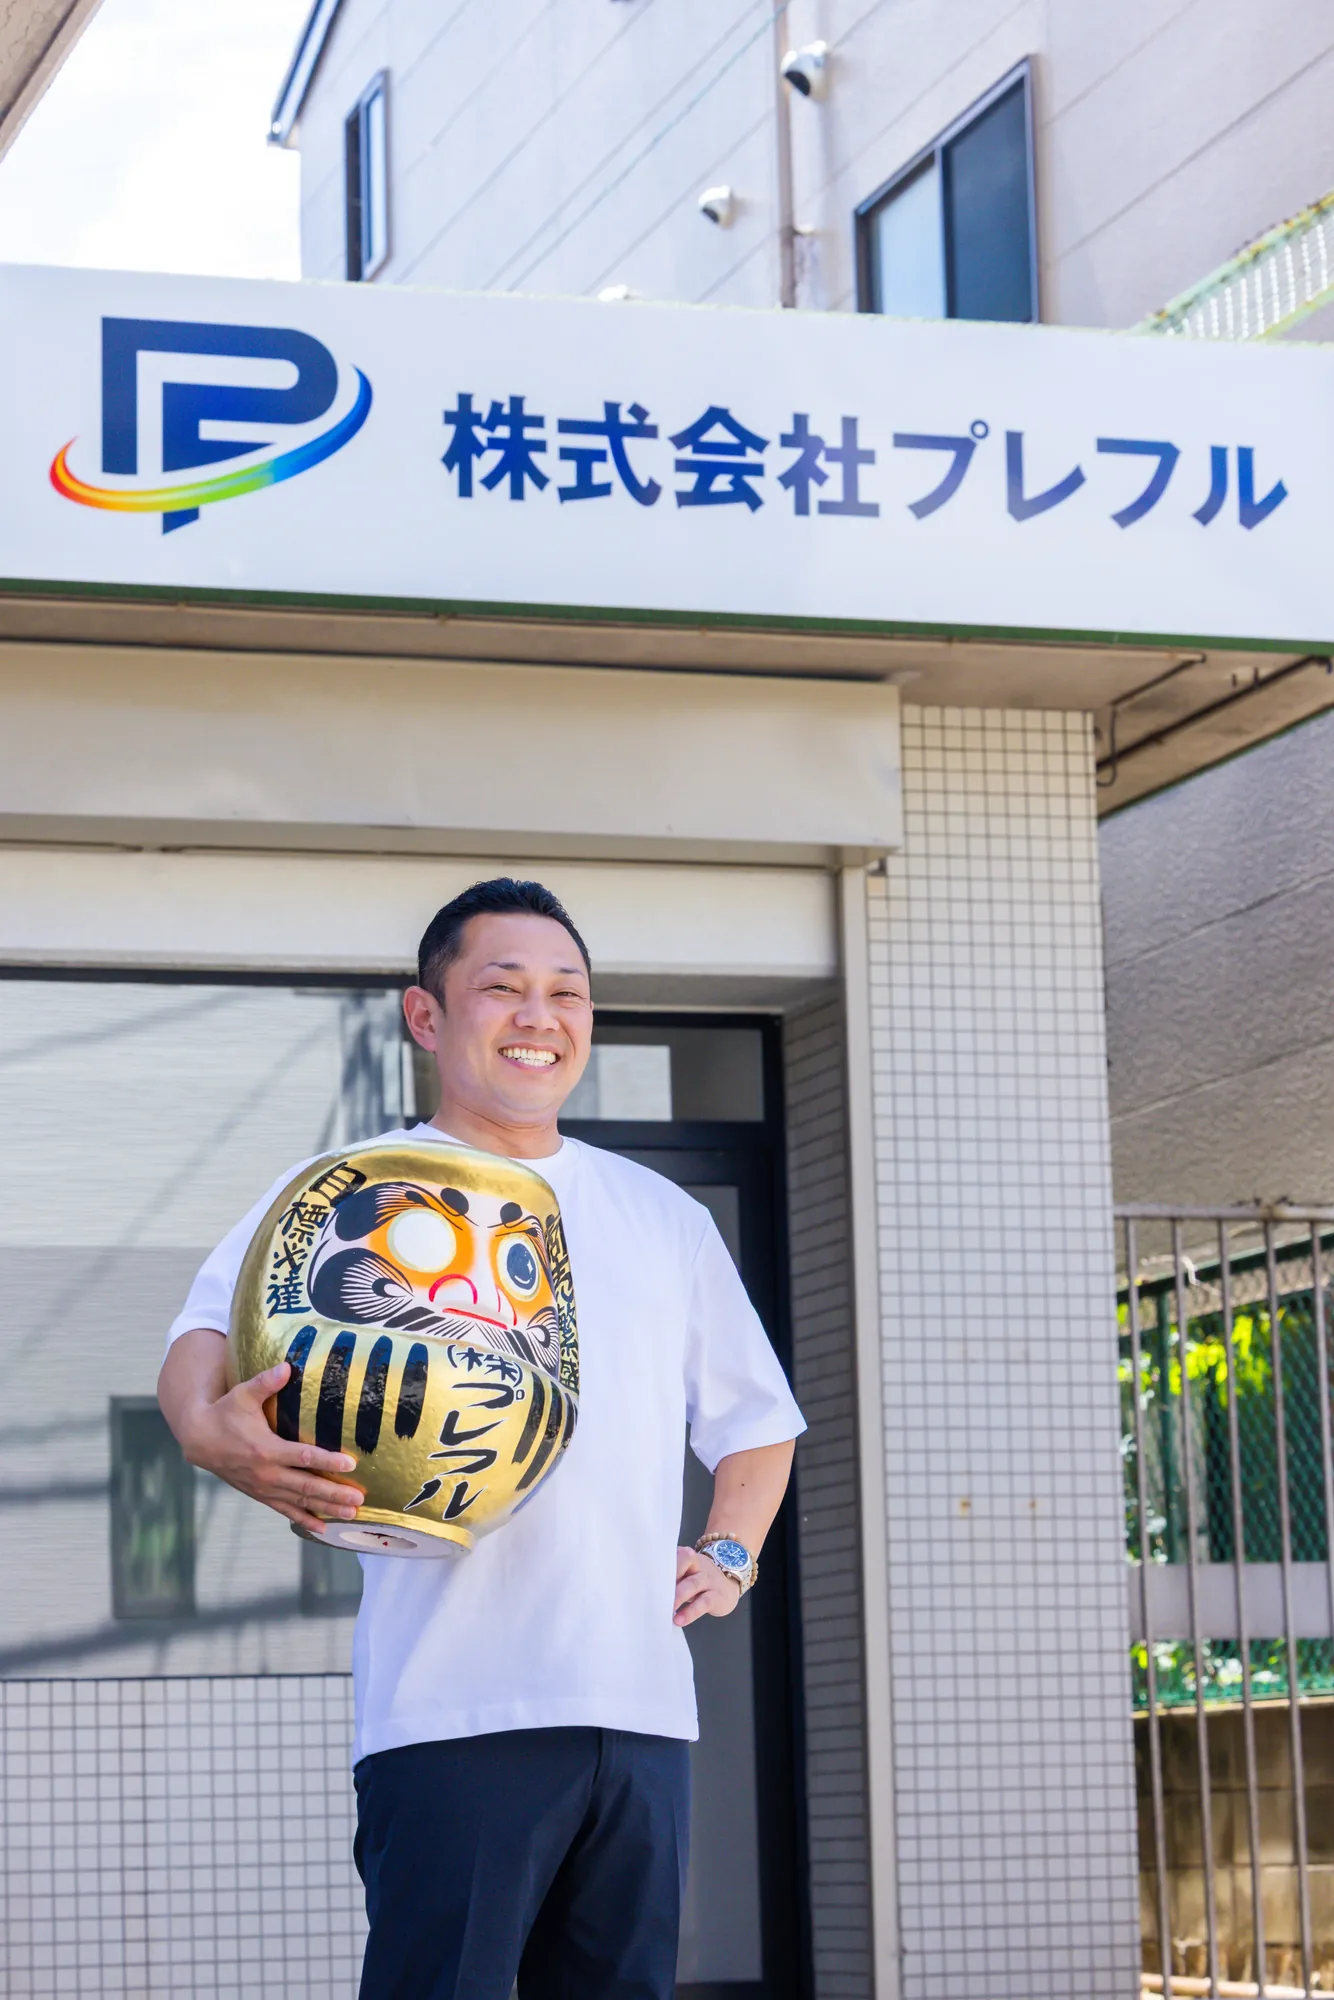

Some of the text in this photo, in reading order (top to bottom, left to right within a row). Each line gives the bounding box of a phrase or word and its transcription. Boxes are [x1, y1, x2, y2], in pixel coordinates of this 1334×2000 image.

[441, 391, 1289, 531] 株式会社プレフル
[266, 1161, 367, 1319] 目標必達
[403, 1378, 525, 1520] プレフル
